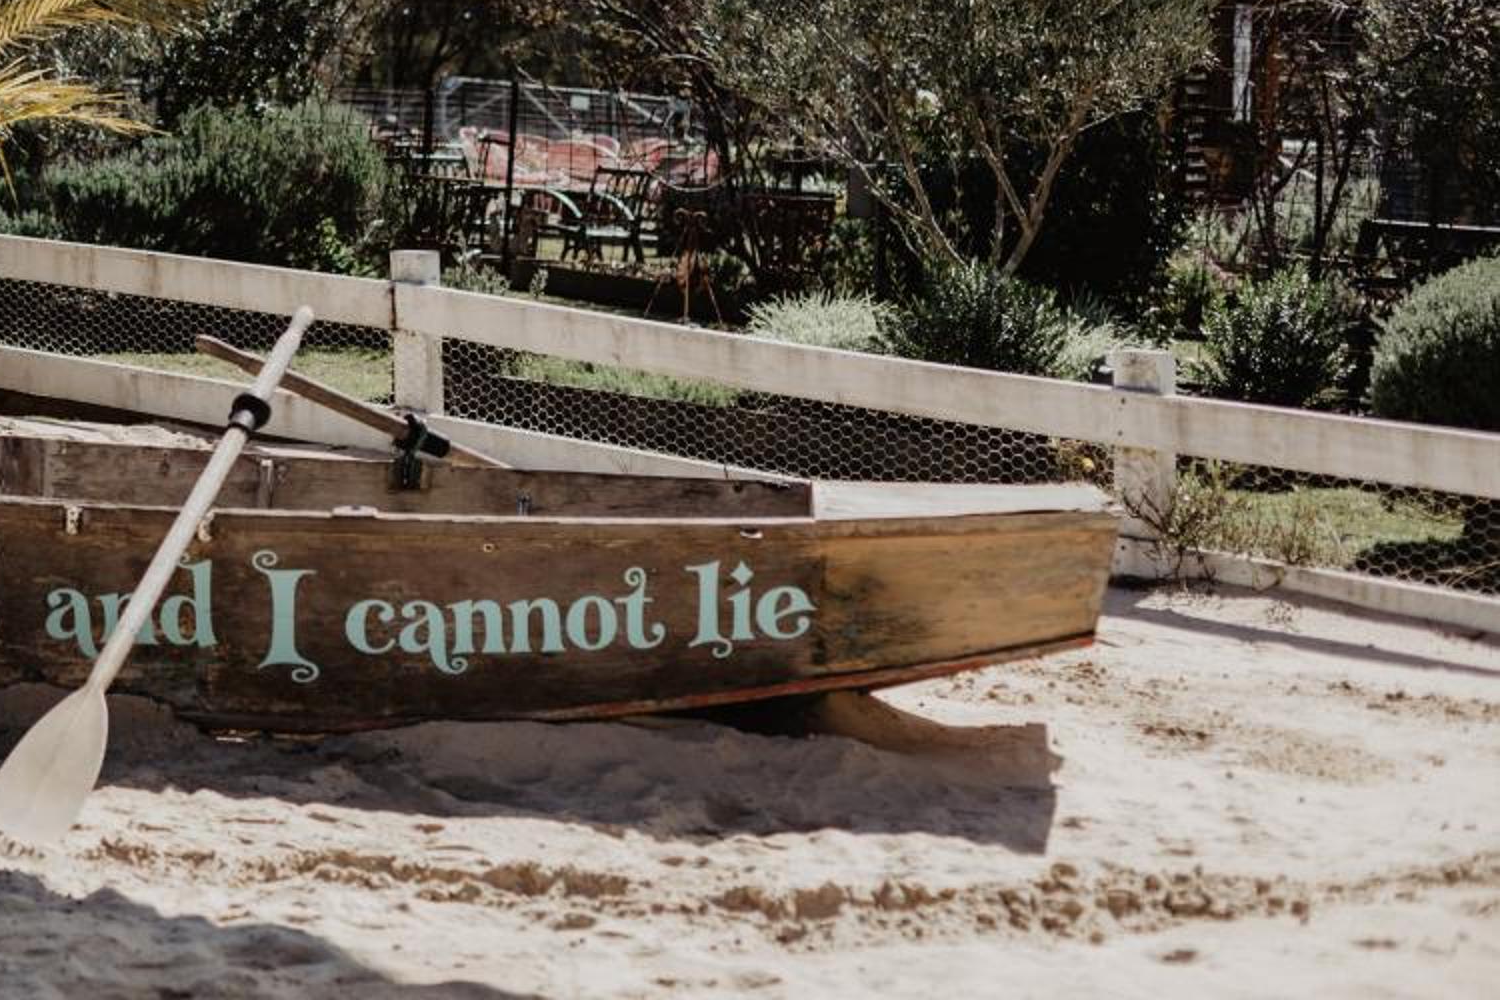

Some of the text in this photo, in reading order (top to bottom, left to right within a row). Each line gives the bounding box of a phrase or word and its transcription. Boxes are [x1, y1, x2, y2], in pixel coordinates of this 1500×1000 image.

[45, 552, 218, 659] and
[252, 550, 320, 683] I
[344, 566, 665, 676] cannot
[685, 560, 816, 659] lie
